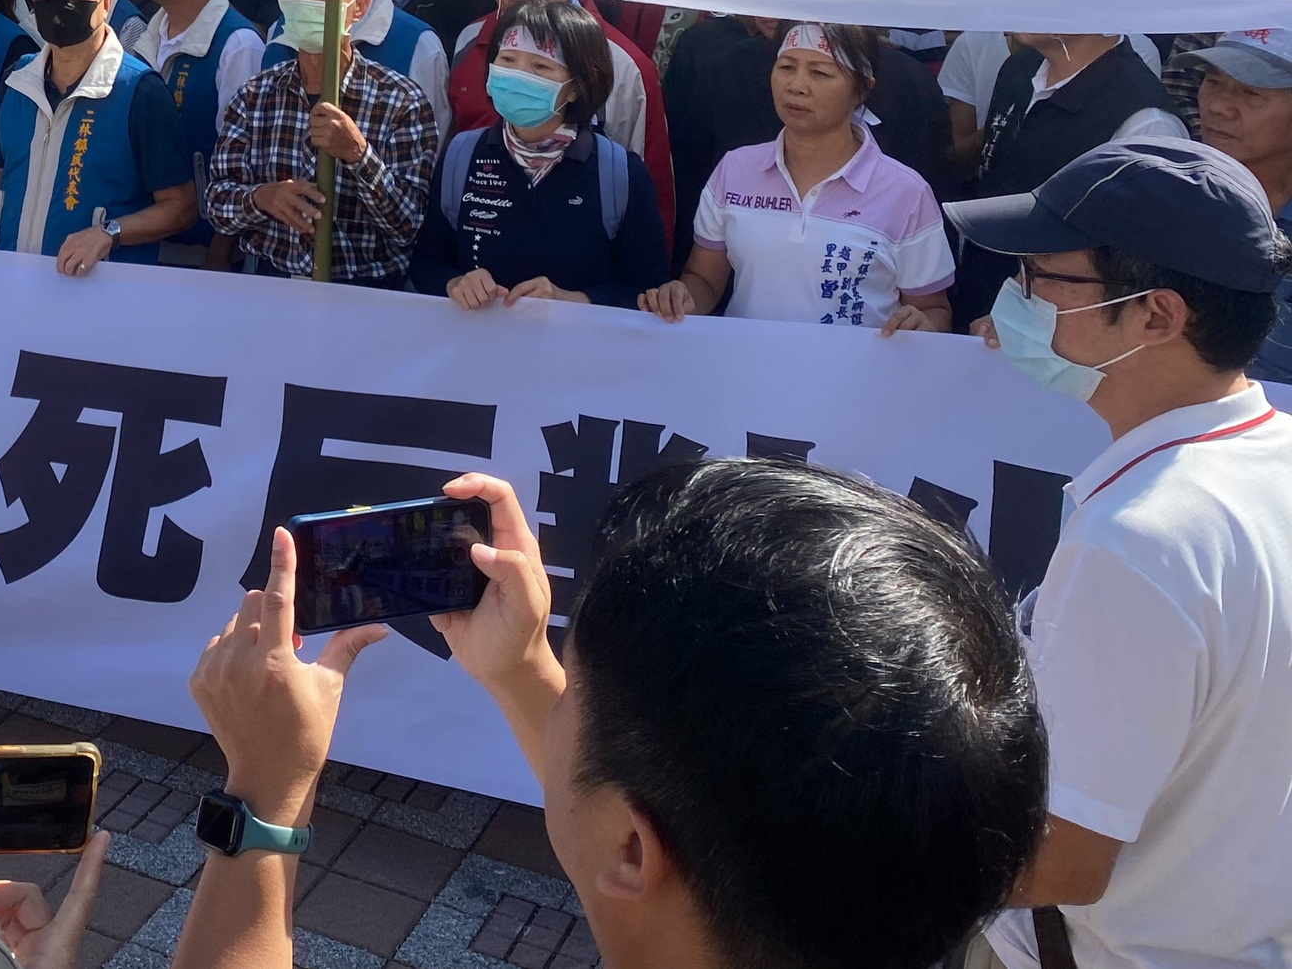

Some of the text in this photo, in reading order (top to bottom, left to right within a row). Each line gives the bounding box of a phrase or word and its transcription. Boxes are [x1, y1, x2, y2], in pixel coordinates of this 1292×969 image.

[64, 110, 95, 211] 二林鎮民代表會
[462, 192, 513, 207] Crocodile
[725, 192, 792, 211] FELIX BUHLER
